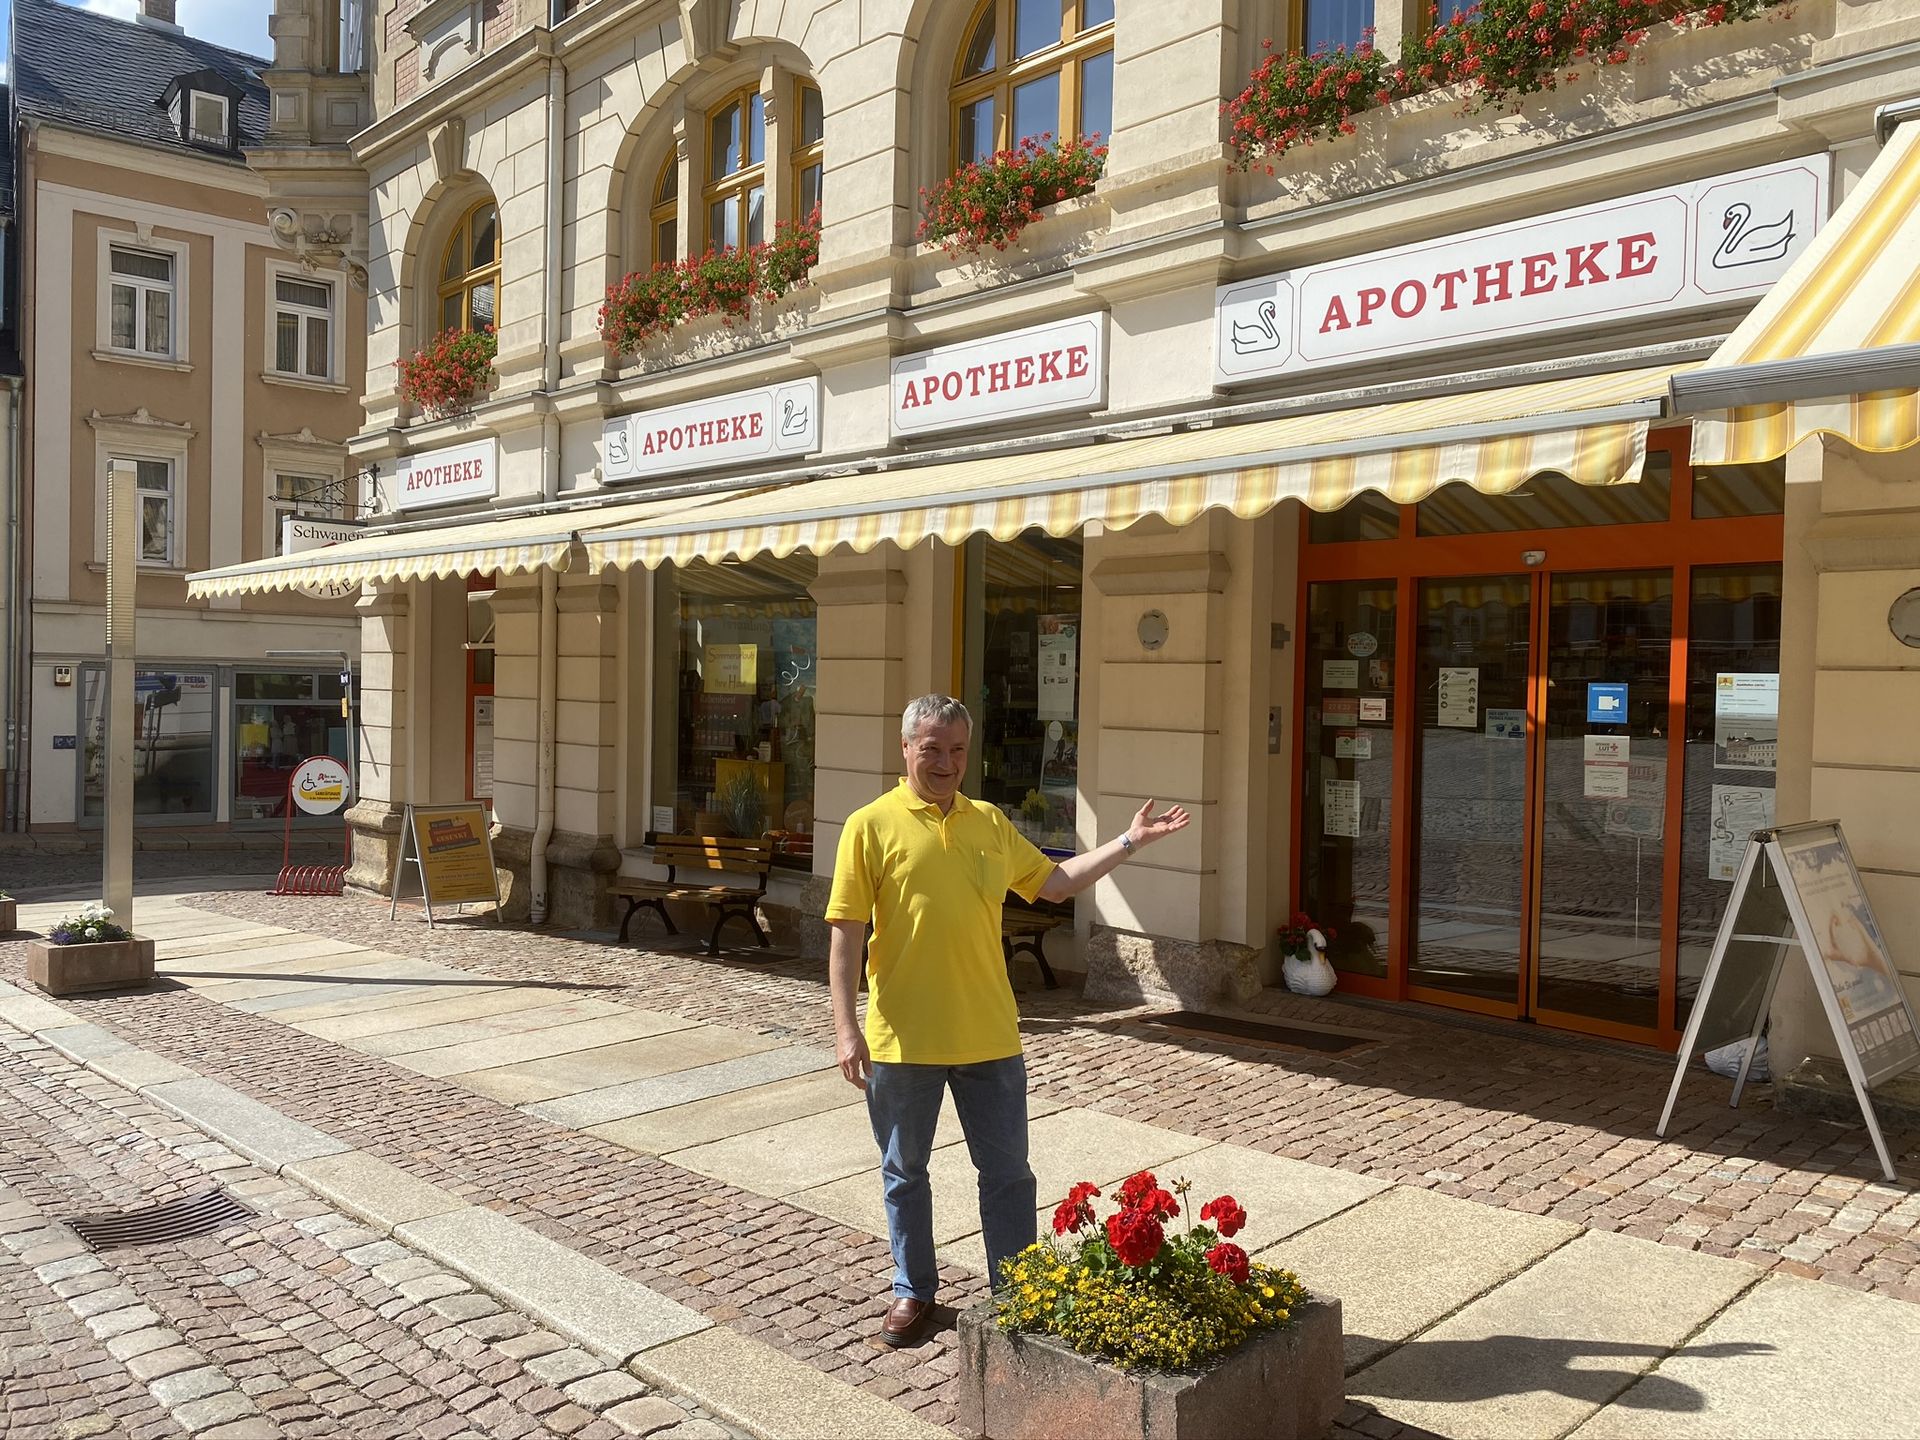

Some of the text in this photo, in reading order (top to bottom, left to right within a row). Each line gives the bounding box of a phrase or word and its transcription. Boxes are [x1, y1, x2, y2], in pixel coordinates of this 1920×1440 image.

[1317, 231, 1658, 335] APOTHEKE
[901, 344, 1089, 410] APOTHEKE
[642, 411, 764, 456] APOTHEKE
[406, 458, 483, 491] APOTHEKE
